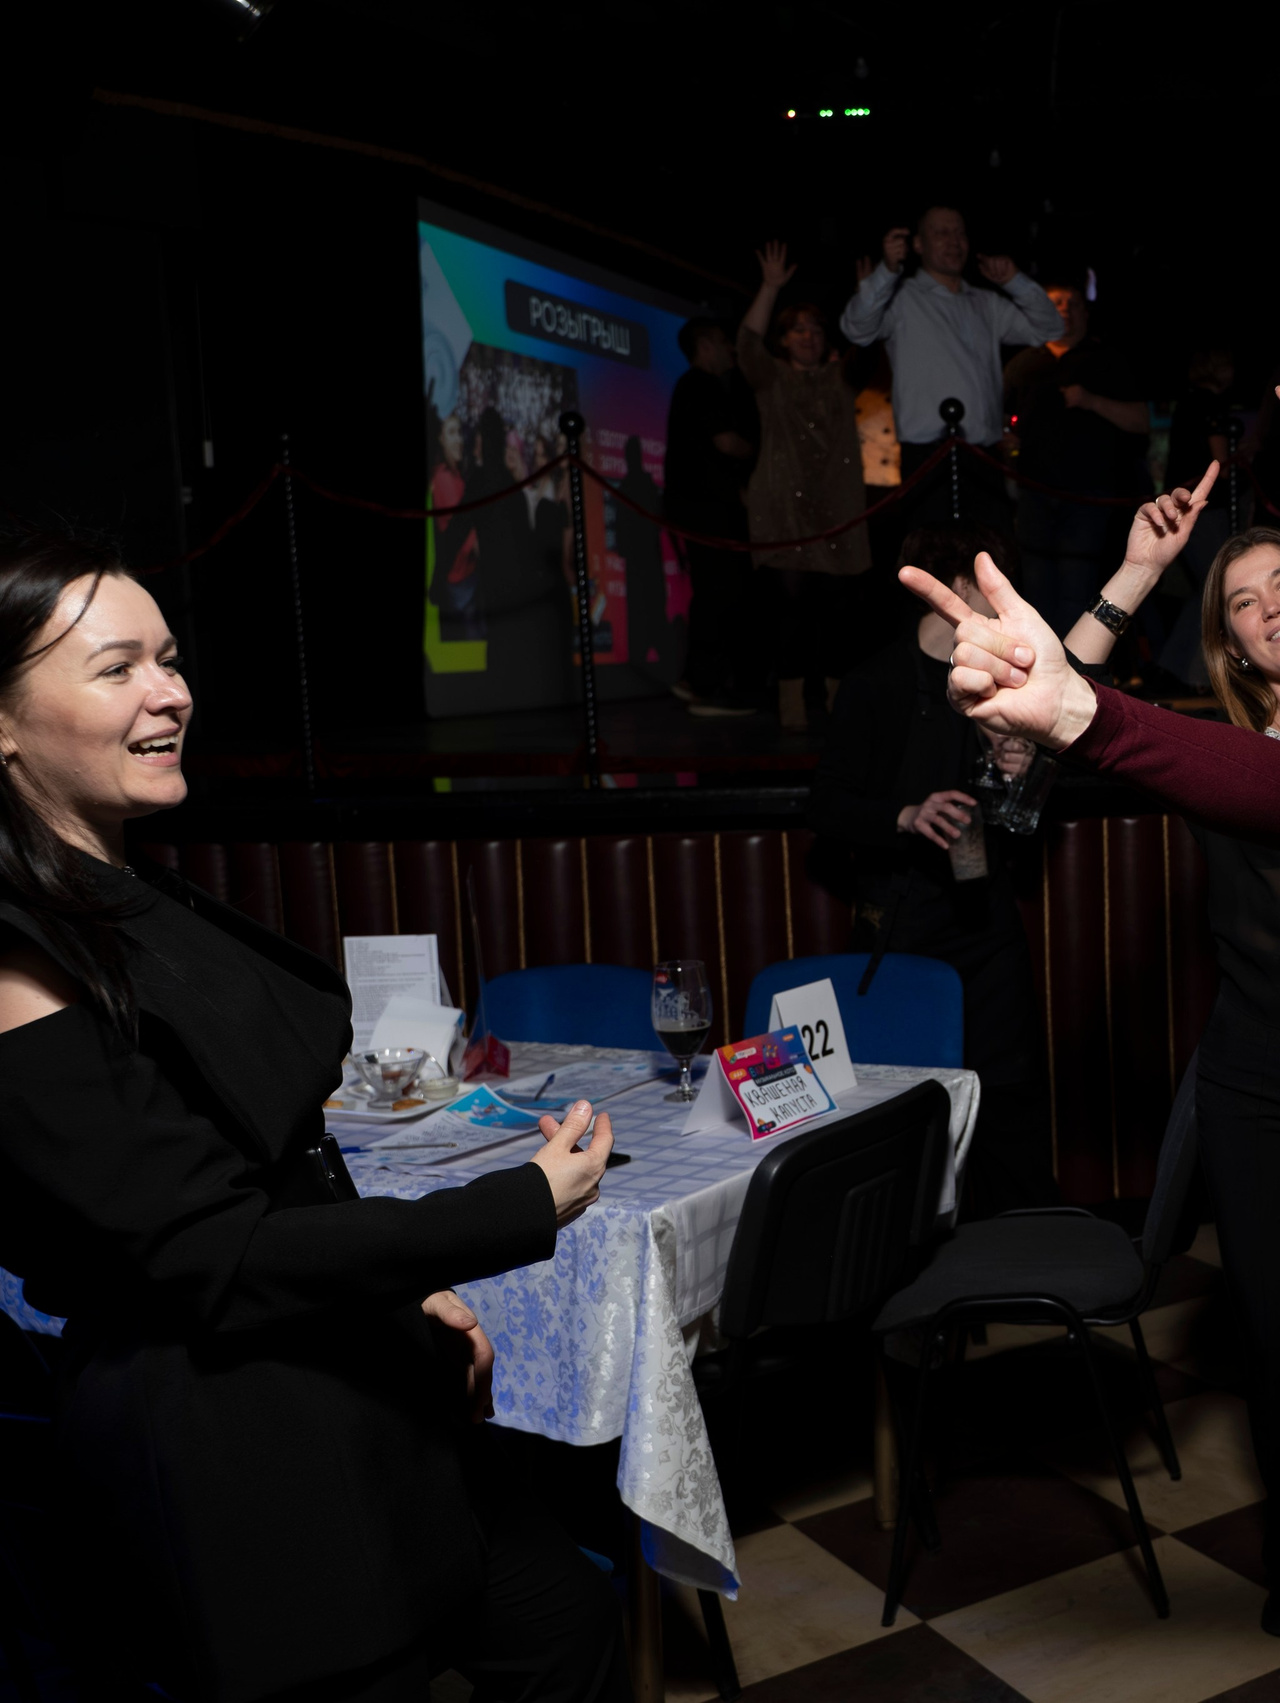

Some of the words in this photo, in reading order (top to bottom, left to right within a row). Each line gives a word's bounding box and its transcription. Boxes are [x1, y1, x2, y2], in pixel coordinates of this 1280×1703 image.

[528, 295, 631, 356] РОЗЫГРЫШ
[802, 1020, 834, 1060] 22
[744, 1076, 807, 1108] КВАШЕНАЯ
[769, 1094, 818, 1124] КАПУСТА
